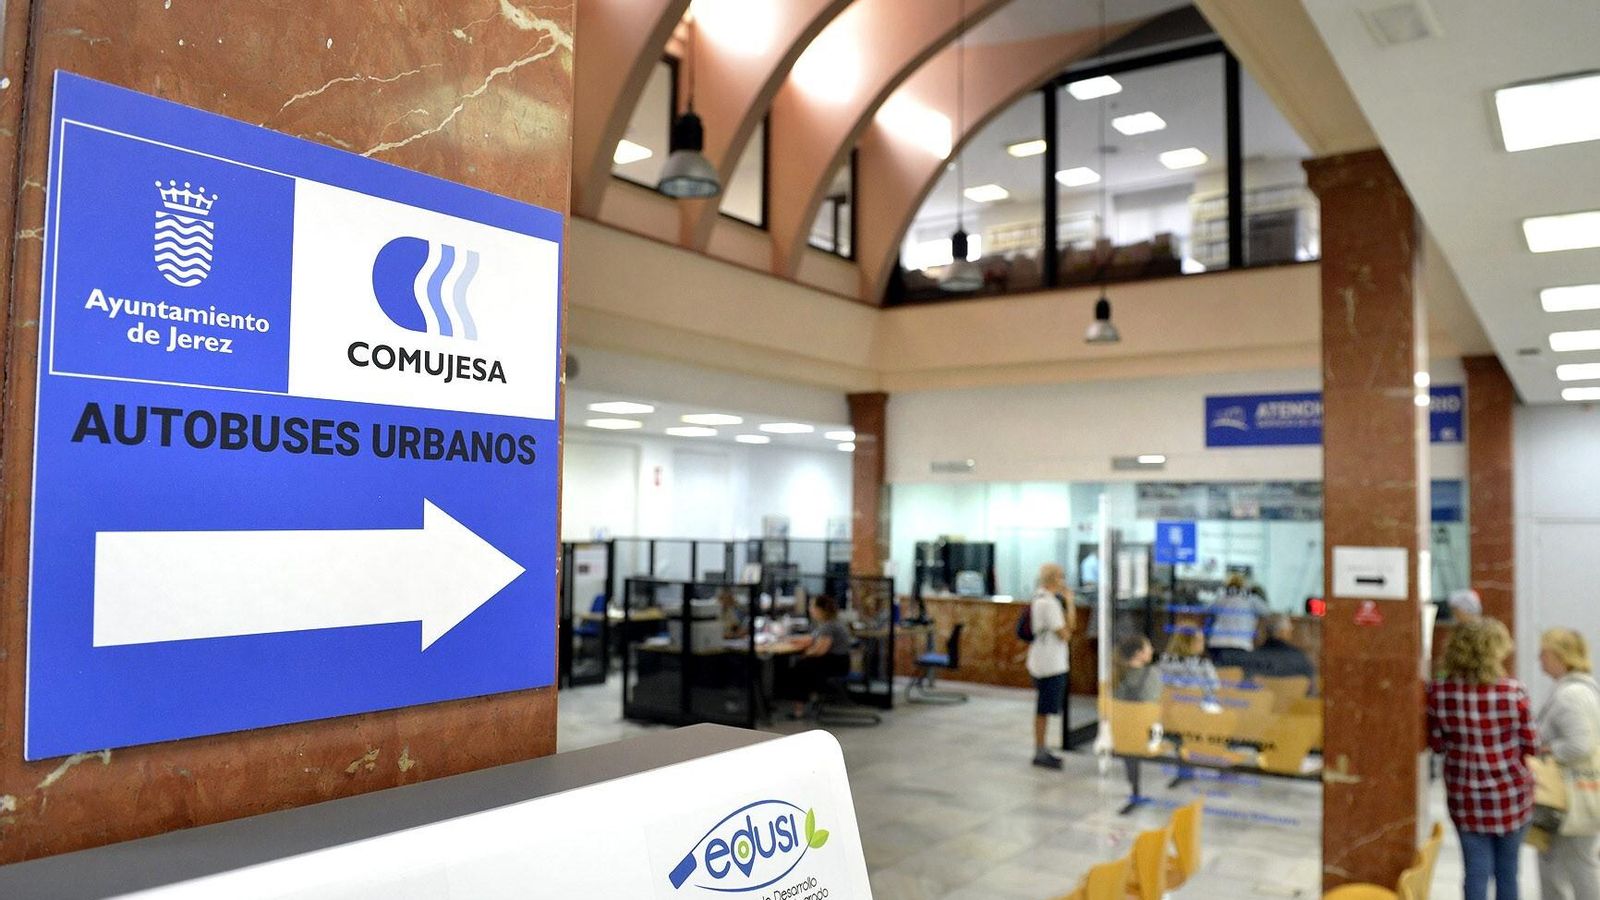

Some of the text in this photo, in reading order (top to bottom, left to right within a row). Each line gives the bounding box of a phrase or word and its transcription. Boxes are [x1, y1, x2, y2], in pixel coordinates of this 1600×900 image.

[84, 288, 270, 333] Ayuntamiento
[128, 321, 233, 354] de Jerez
[347, 341, 507, 385] COMUJESA
[71, 402, 536, 466] AUTOBUSES URBANOS
